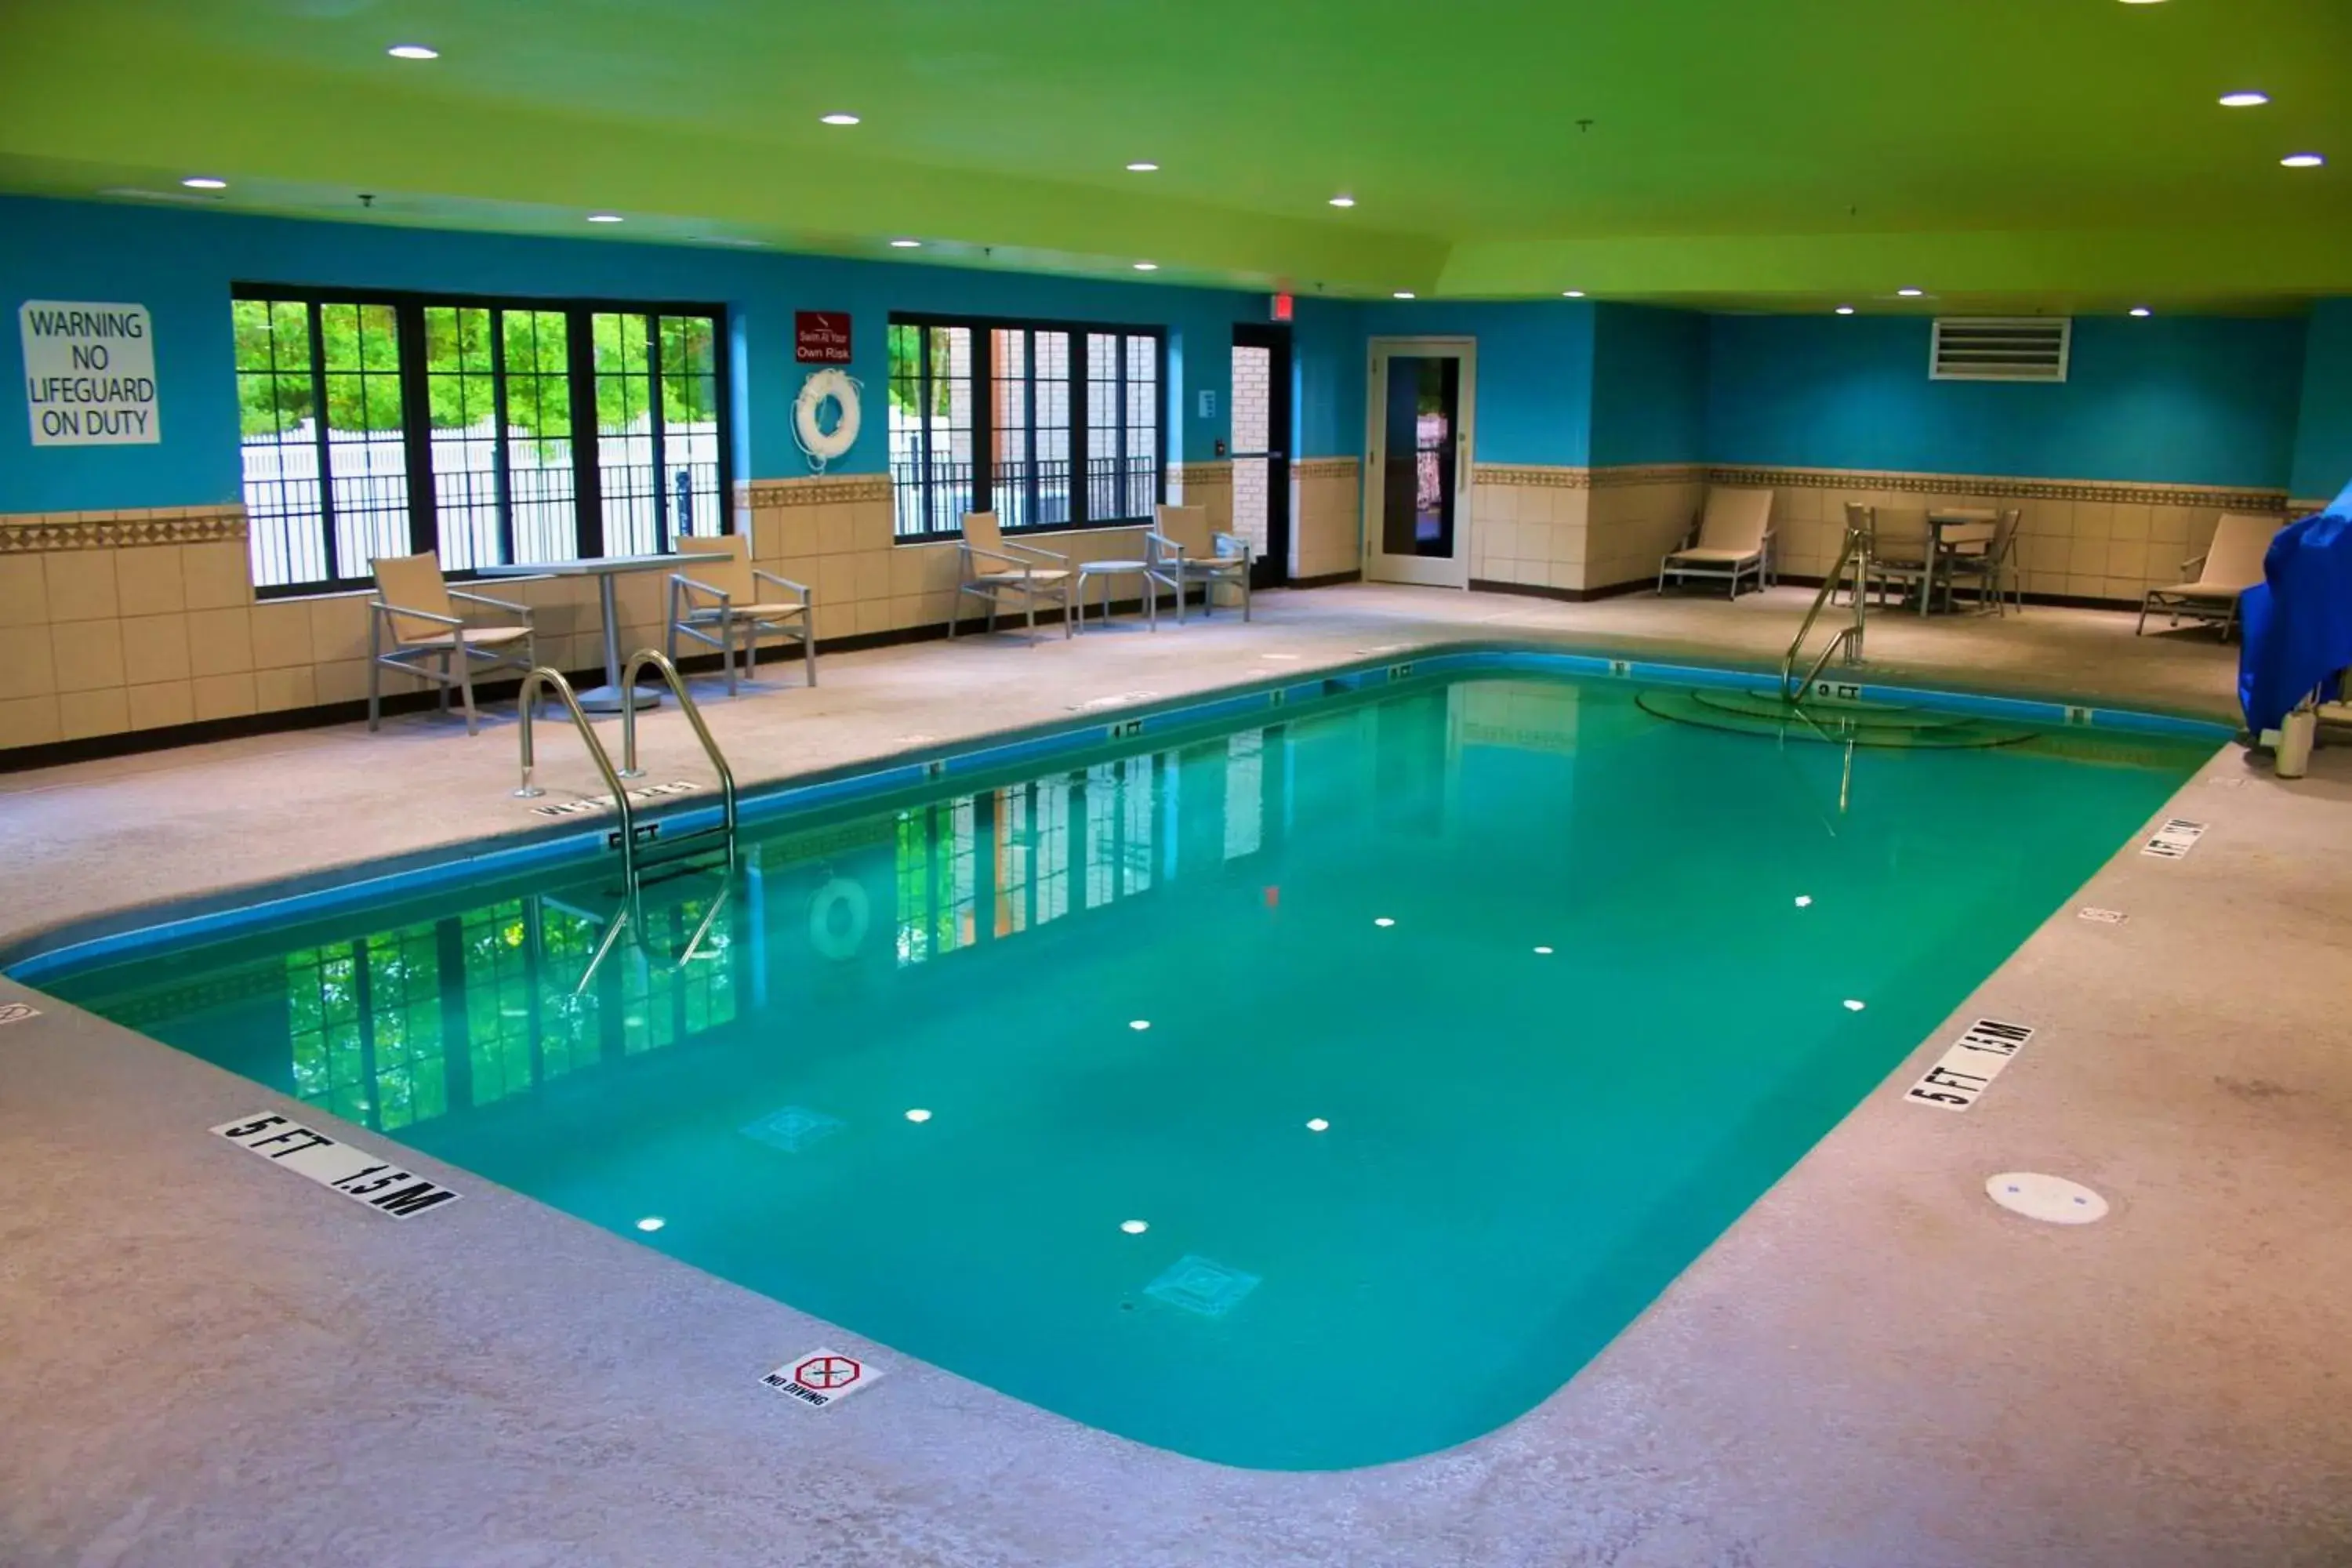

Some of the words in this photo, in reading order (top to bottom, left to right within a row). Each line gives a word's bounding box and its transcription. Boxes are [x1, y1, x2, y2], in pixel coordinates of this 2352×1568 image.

[29, 311, 143, 338] WARNING
[72, 344, 108, 370] NO
[797, 346, 823, 358] Own
[29, 377, 154, 403] LIFEGUARD
[42, 410, 79, 437] ON
[86, 410, 148, 436] DUTY
[1973, 1020, 2032, 1041] M
[1959, 1036, 2018, 1056] 1.5
[1924, 1066, 1988, 1092] FT
[1910, 1088, 1969, 1105] 5
[225, 1116, 288, 1138] 5
[249, 1128, 335, 1158] FT
[331, 1164, 412, 1194] 1.5
[369, 1181, 457, 1216] M
[762, 1374, 787, 1387] NO
[784, 1382, 829, 1406] DIVING
